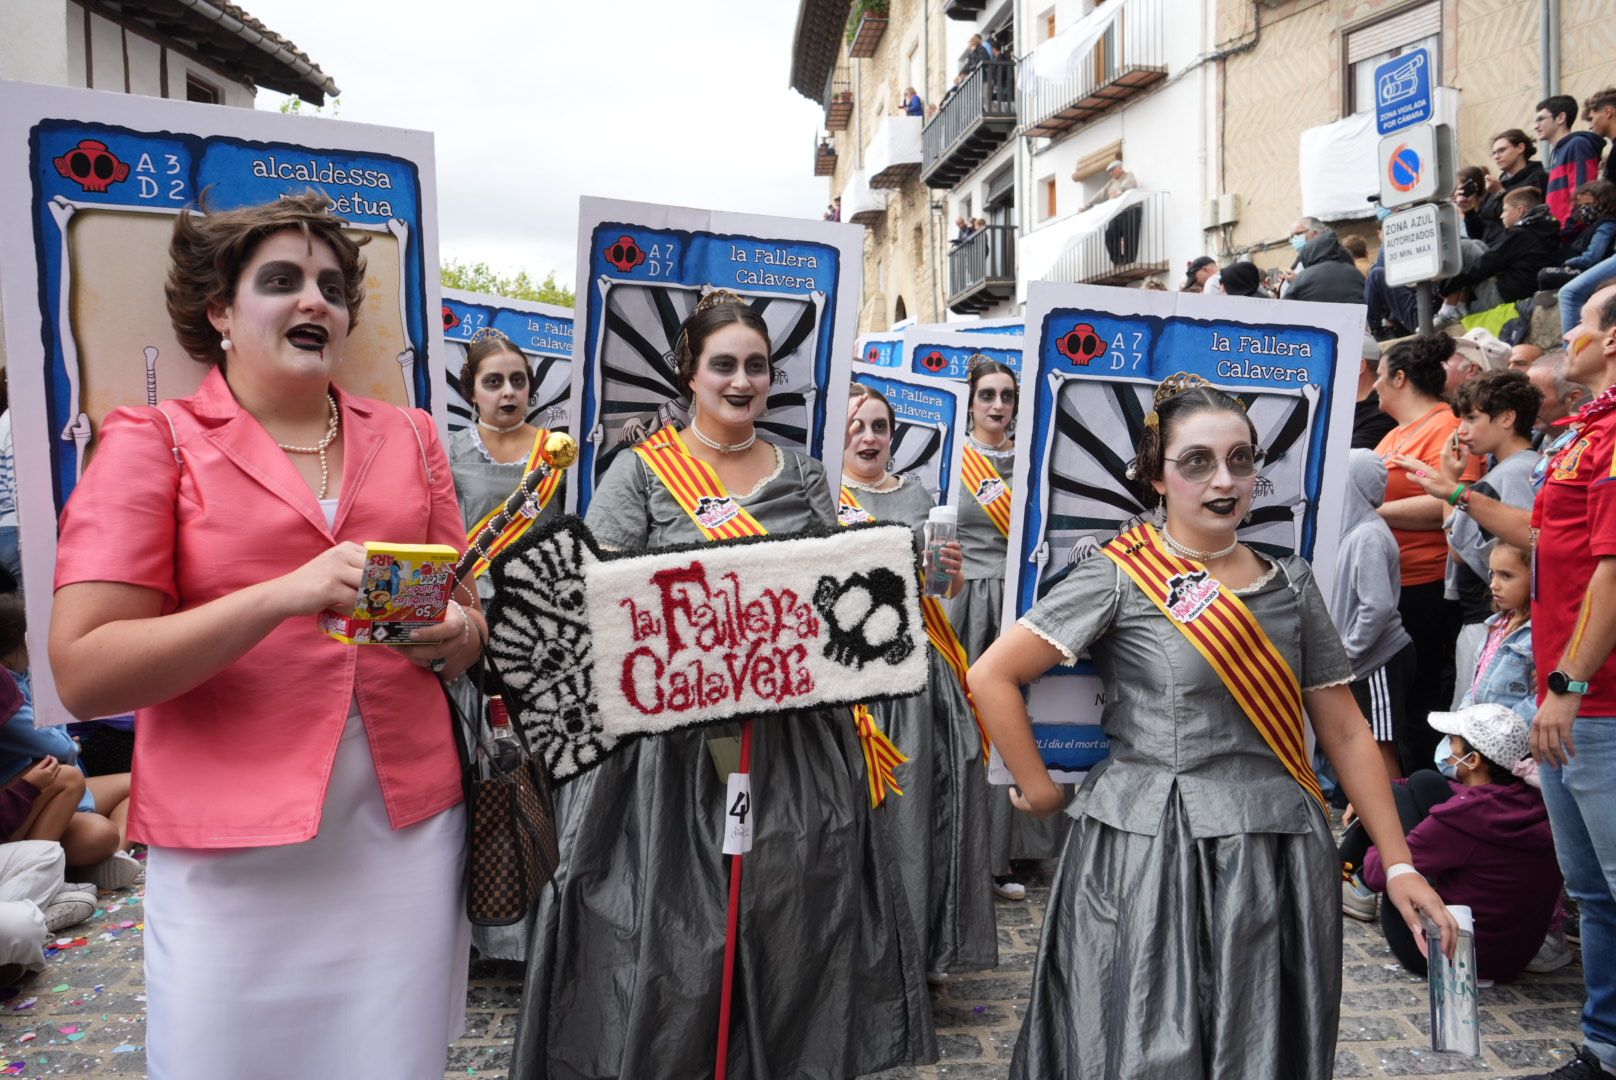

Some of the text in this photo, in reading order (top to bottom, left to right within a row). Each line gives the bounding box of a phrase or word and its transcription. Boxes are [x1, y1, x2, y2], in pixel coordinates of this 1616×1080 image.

[1380, 99, 1426, 121] ZONA VIGILADA
[1383, 119, 1396, 130] POR
[136, 153, 180, 174] A 3
[252, 156, 392, 189] alcaldessa
[137, 176, 184, 199] D 2
[1386, 213, 1433, 235] ZONA AZUL
[1387, 228, 1435, 248] AUTORIZADOS
[649, 244, 674, 259] A 7
[730, 245, 818, 268] la Fallera
[649, 261, 674, 277] D 7
[736, 269, 816, 289] Calavera
[463, 314, 472, 324] A
[528, 320, 539, 331] la
[1111, 333, 1142, 349] A 7
[1211, 332, 1312, 358] la Fallera
[1005, 355, 1016, 365] la
[1110, 352, 1142, 370] D 7
[1216, 360, 1309, 382] Calavera
[885, 385, 942, 406] la Fallera
[416, 606, 431, 617] 50
[619, 560, 819, 665] la Fallera
[1048, 739, 1063, 749] diu
[1065, 739, 1075, 749] el
[1075, 740, 1099, 749] mort
[729, 791, 750, 824] 4
